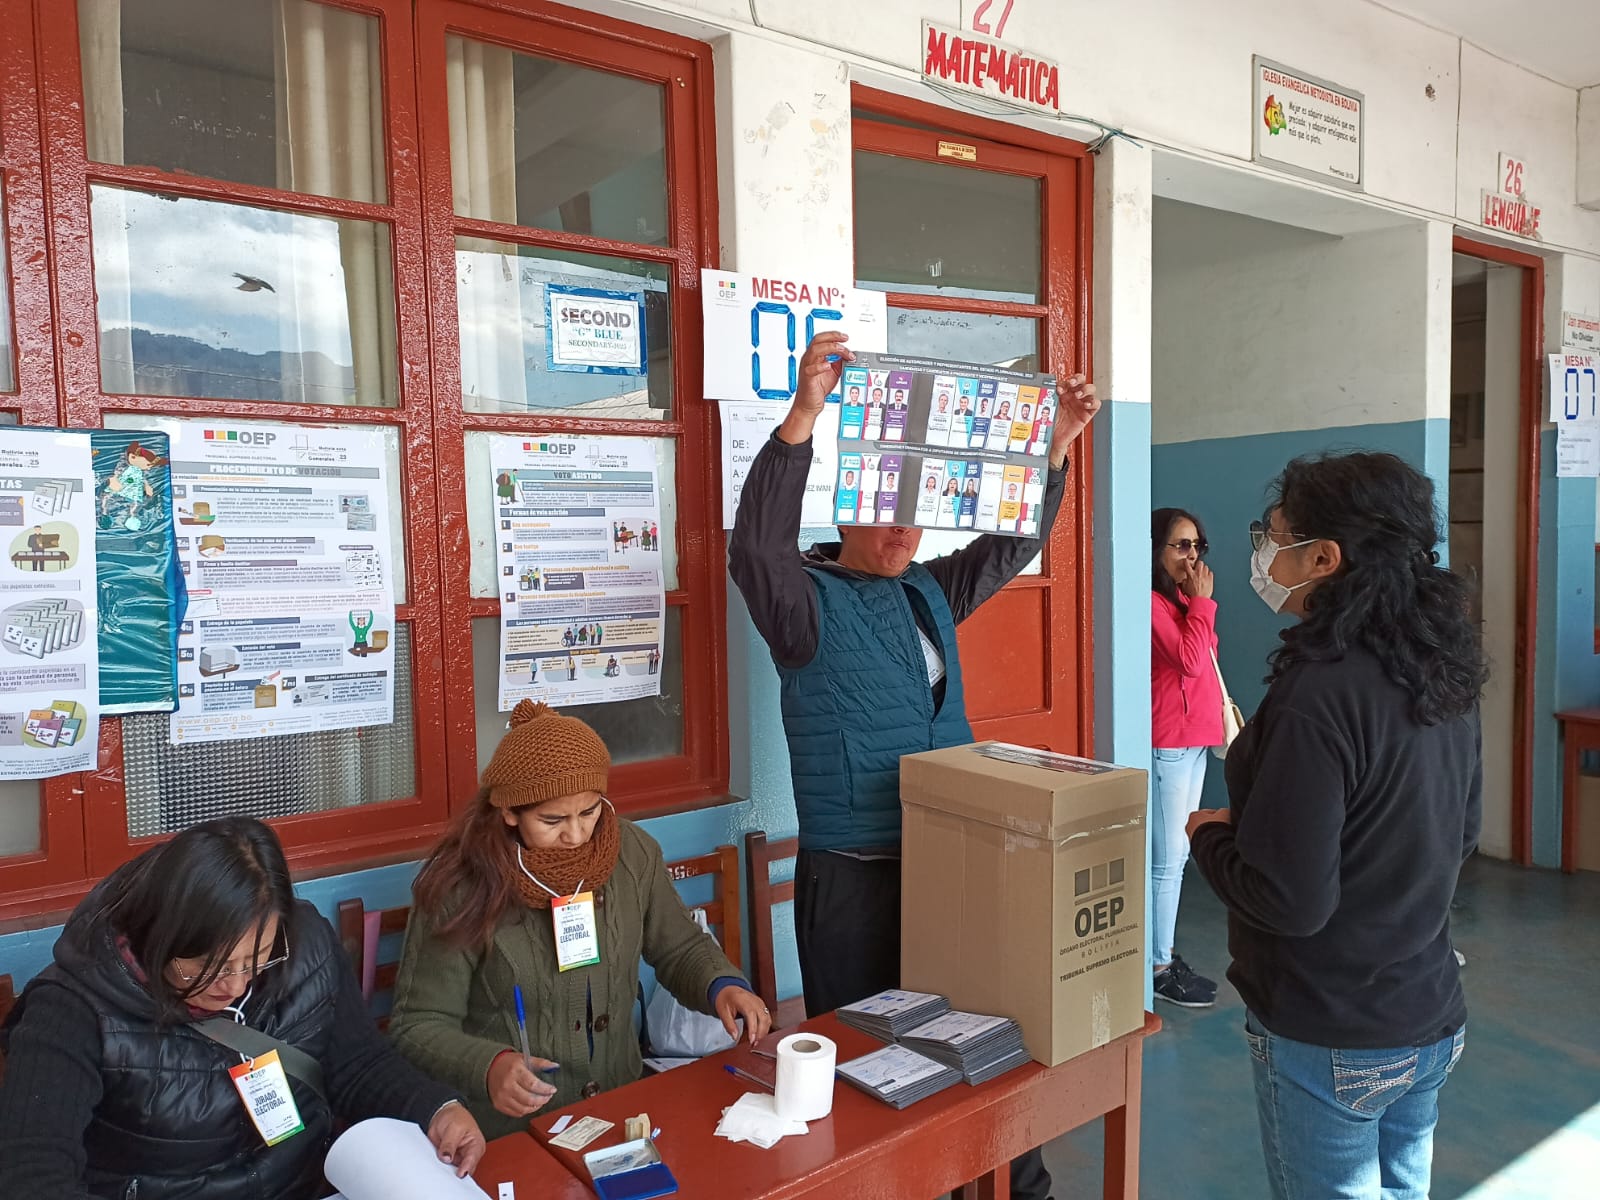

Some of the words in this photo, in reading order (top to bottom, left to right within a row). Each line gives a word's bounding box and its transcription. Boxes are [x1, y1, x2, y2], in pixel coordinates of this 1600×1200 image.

[1263, 68, 1281, 86] IGLESIA
[1310, 86, 1334, 104] METODISTA
[1334, 94, 1341, 106] EN
[1341, 95, 1358, 112] BOLIVIA
[1504, 159, 1523, 196] 26
[719, 290, 736, 299] OEP
[752, 277, 812, 304] MESA
[560, 307, 631, 328] SECOND
[594, 328, 624, 341] BLUE
[1565, 355, 1584, 367] MESA
[1565, 368, 1596, 421] 07
[239, 431, 276, 445] OEP
[549, 443, 576, 455] OEP
[209, 464, 284, 475] PROCEDIMIENTO
[285, 467, 297, 476] DE
[553, 471, 571, 480] VOTO
[0, 479, 23, 489] TAS
[181, 650, 193, 658] 5to
[181, 685, 193, 694] 6to
[1074, 896, 1125, 938] OEP
[563, 923, 585, 935] JURADO
[560, 930, 591, 944] ELECTORAL
[1079, 935, 1105, 950] ELECTORAL
[1104, 923, 1139, 940] PLURINACIONAL
[1060, 967, 1086, 983] TRIBUNAL
[1086, 957, 1110, 973] SUPREMO
[1110, 947, 1139, 964] ELECTORAL
[254, 1089, 277, 1107] JURADO
[254, 1096, 286, 1117] ELECTORAL
